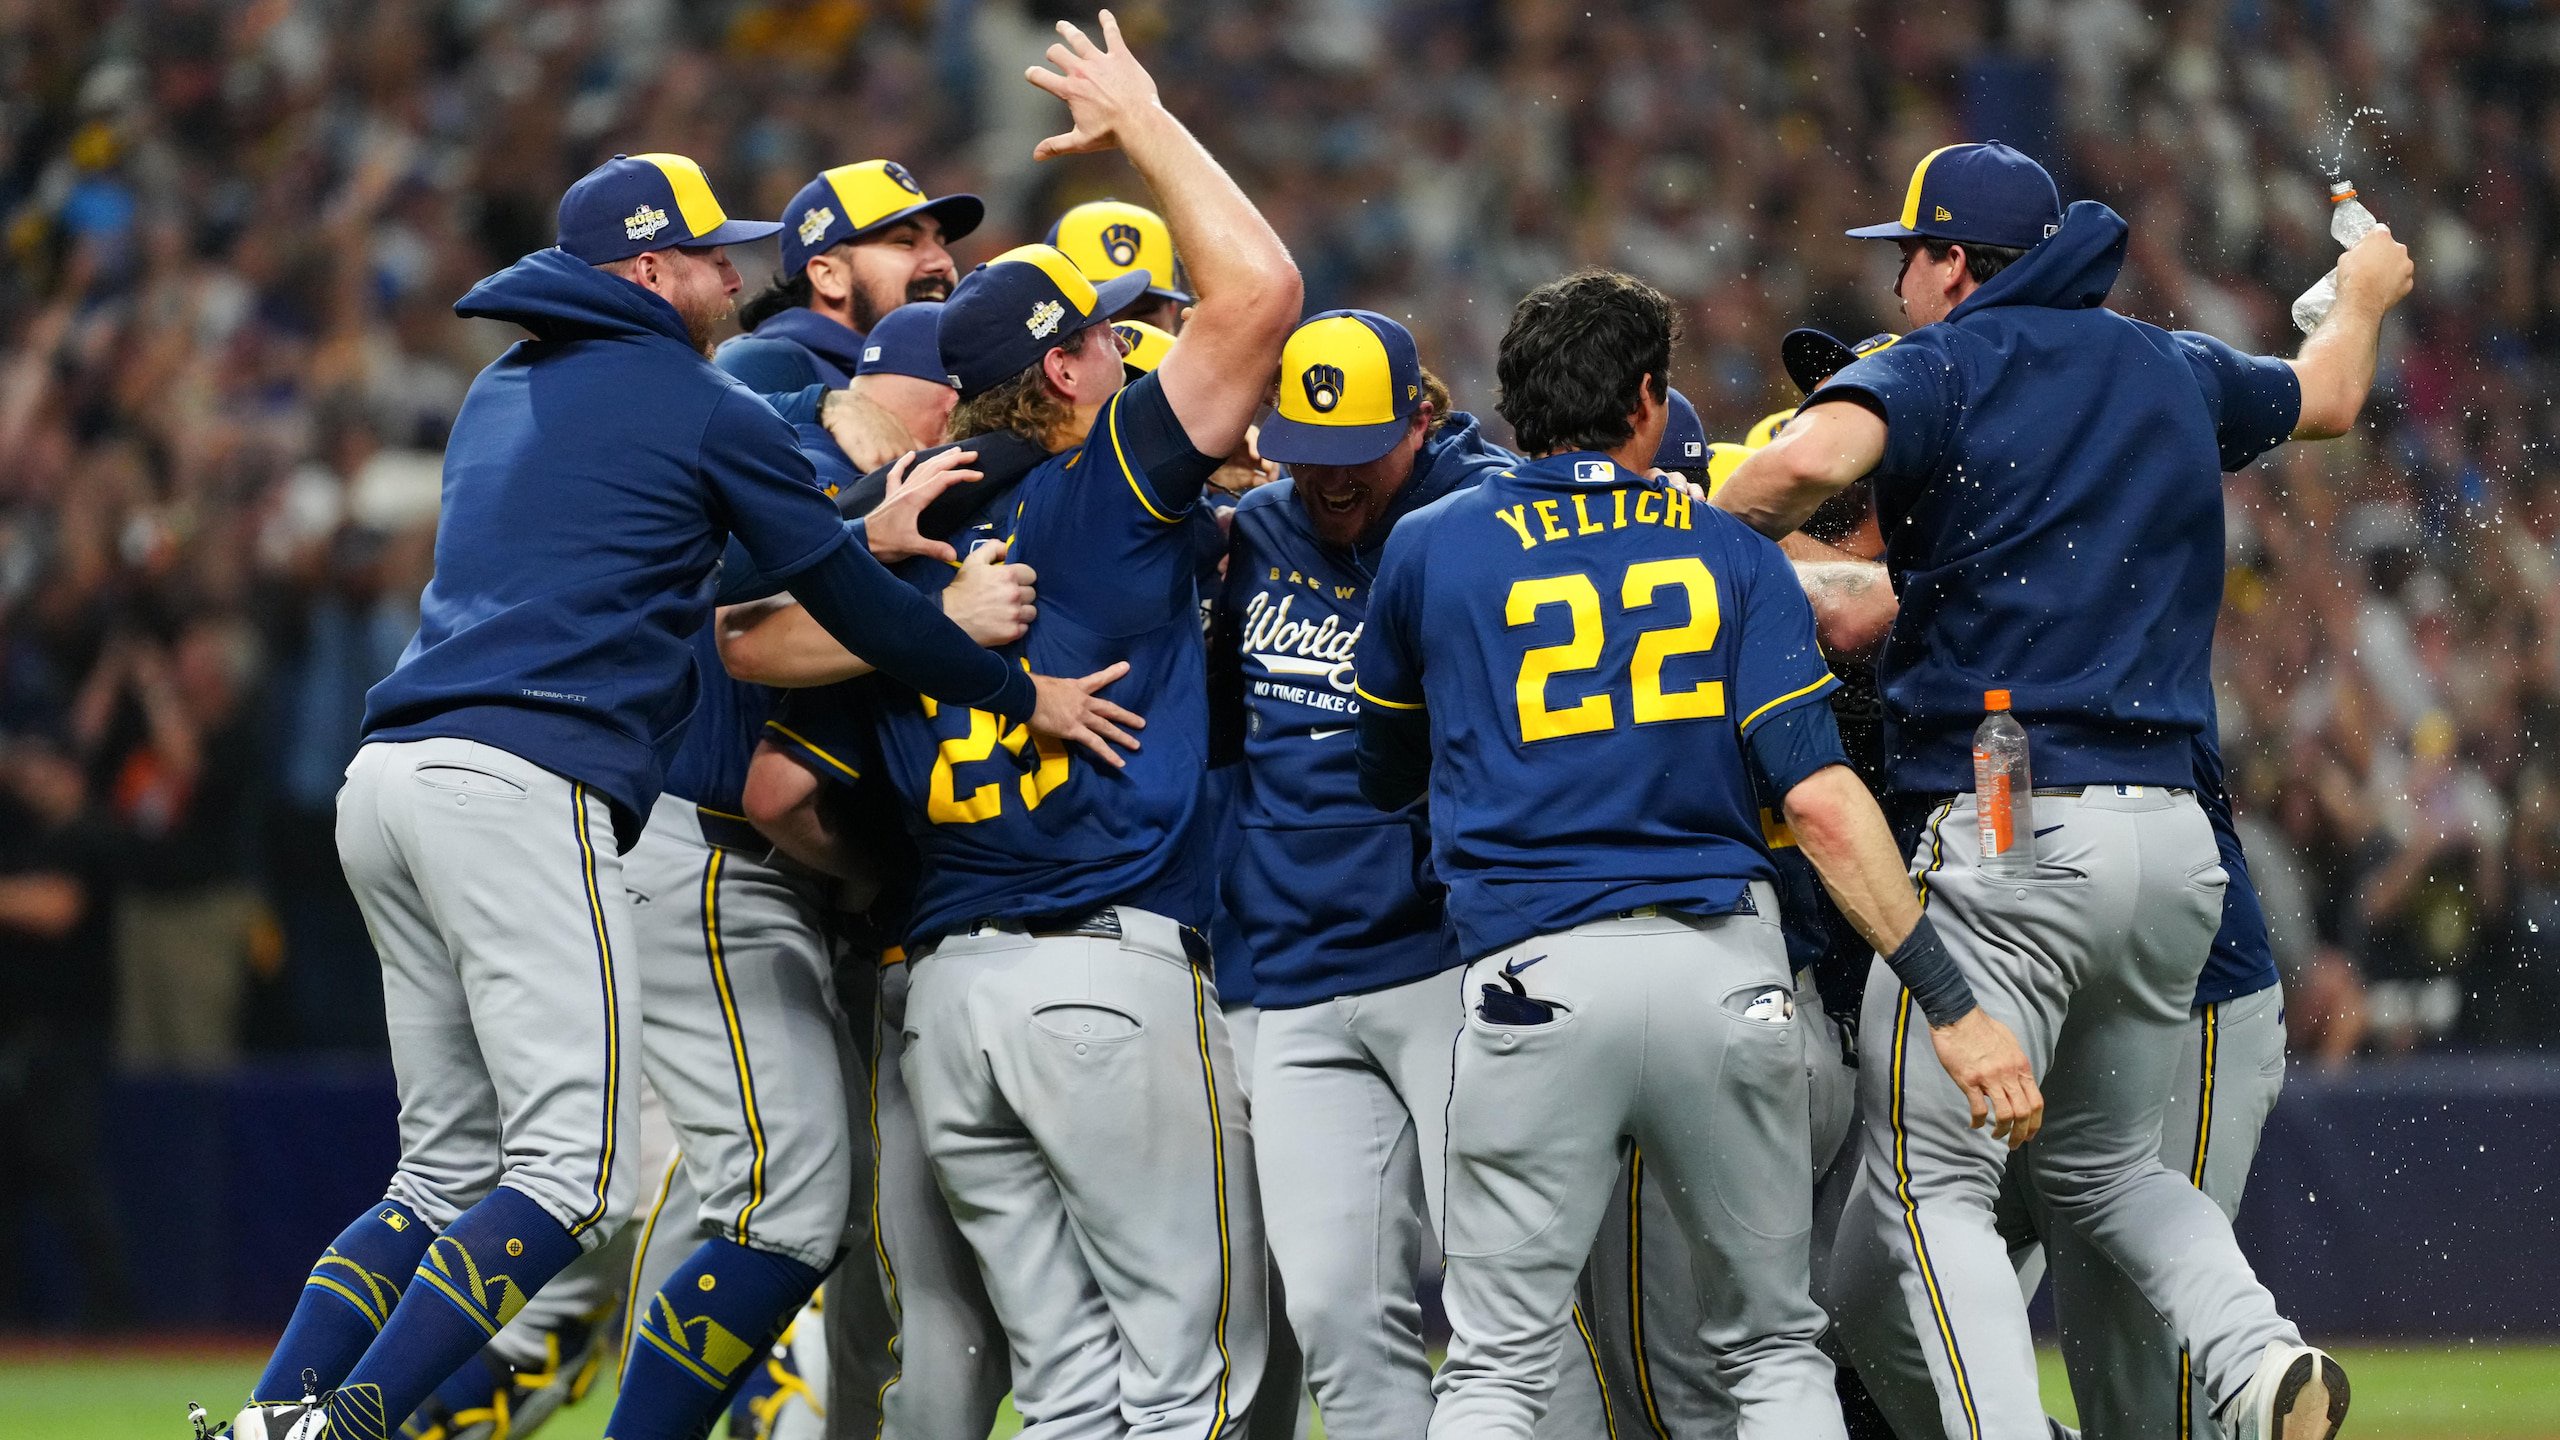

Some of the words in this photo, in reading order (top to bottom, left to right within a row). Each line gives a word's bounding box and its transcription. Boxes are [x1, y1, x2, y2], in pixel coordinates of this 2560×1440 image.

[624, 208, 666, 229] 2026
[1495, 487, 1693, 550] YELICH
[1242, 590, 1365, 662] World
[1504, 556, 1726, 743] 22
[521, 688, 588, 703] THERMA-FIT
[1254, 680, 1270, 697] NO
[1272, 683, 1307, 704] TIME
[1306, 689, 1347, 713] LIKE
